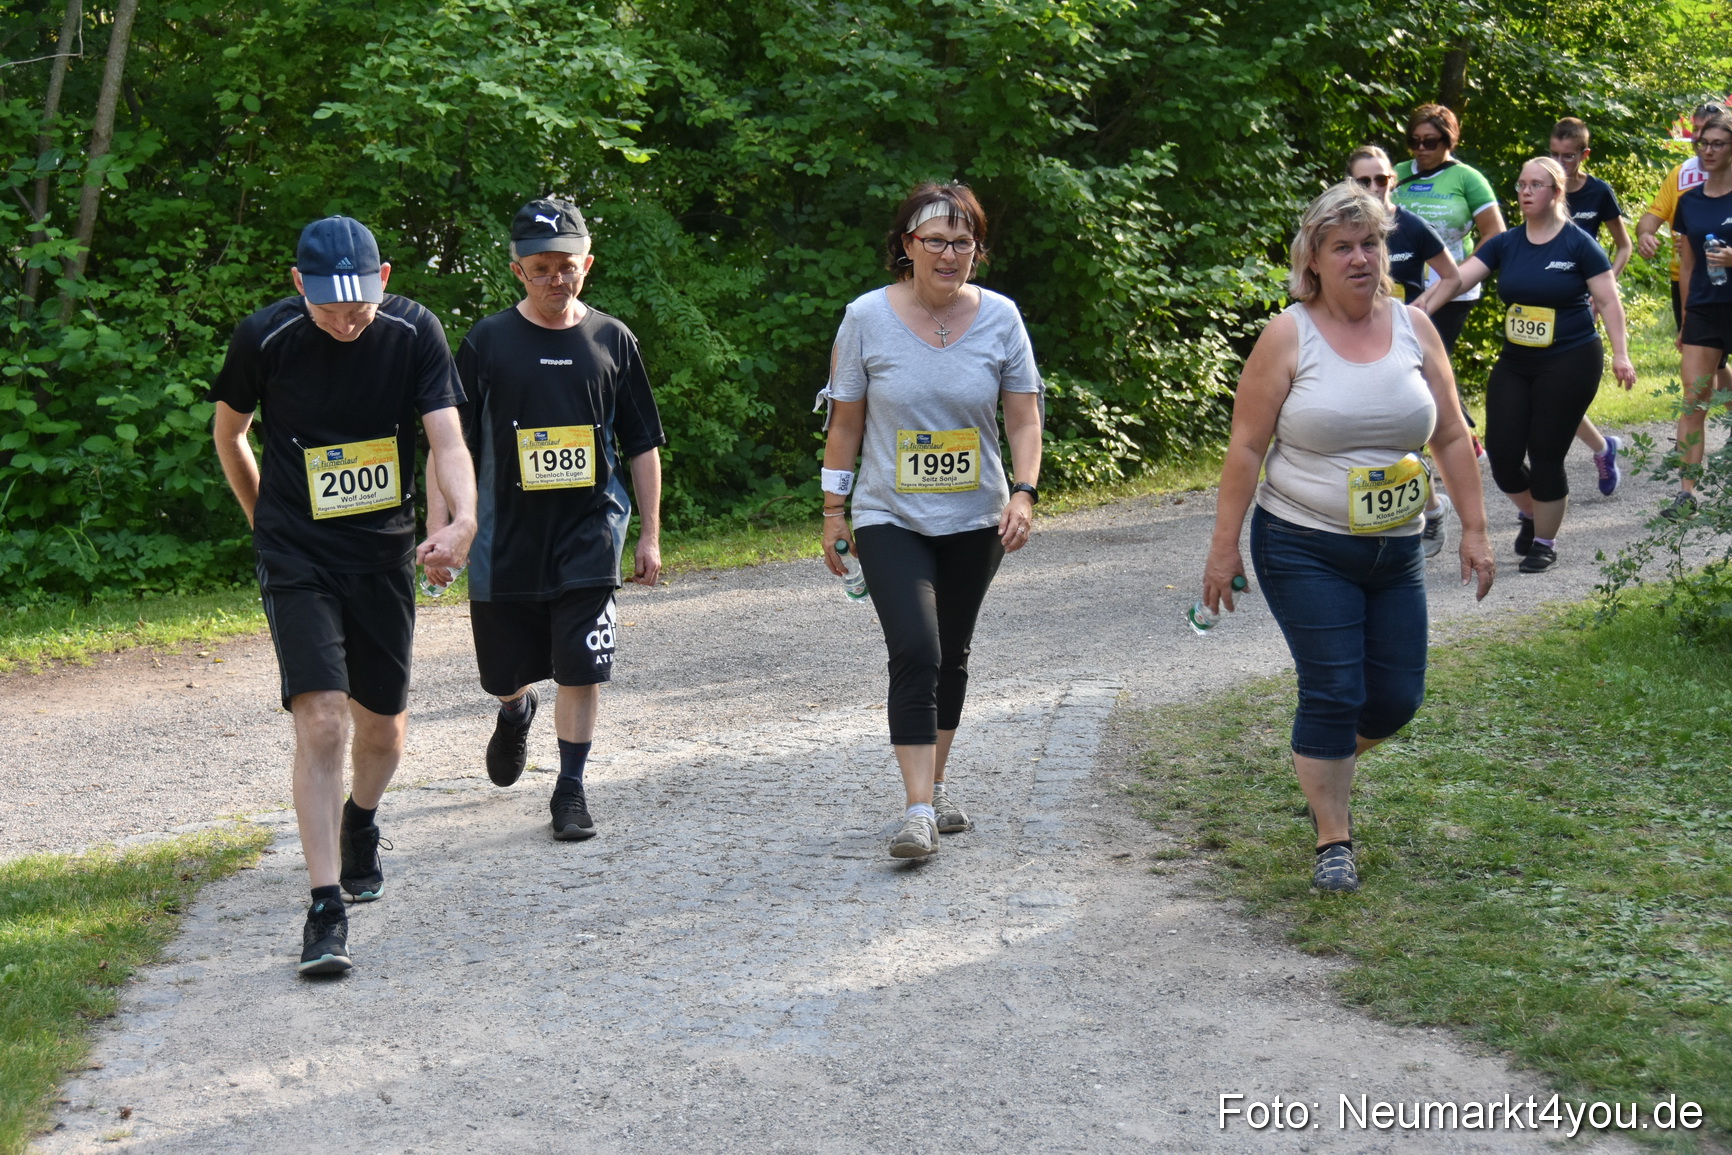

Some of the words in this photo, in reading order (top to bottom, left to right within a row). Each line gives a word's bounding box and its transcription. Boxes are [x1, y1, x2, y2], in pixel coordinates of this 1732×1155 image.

[1510, 318, 1546, 336] 1396
[321, 456, 358, 467] firmenlauf
[529, 447, 587, 472] 1988
[908, 451, 970, 475] 1995
[320, 464, 389, 498] 2000
[535, 471, 564, 479] Obenloch
[939, 475, 957, 483] Sonja
[341, 494, 357, 503] Wolf
[359, 492, 377, 501] Josef
[1361, 478, 1420, 515] 1973
[337, 502, 355, 510] Wagner
[355, 499, 373, 508] Stiftung
[1376, 511, 1394, 520] Klose
[1396, 506, 1410, 514] Heidi
